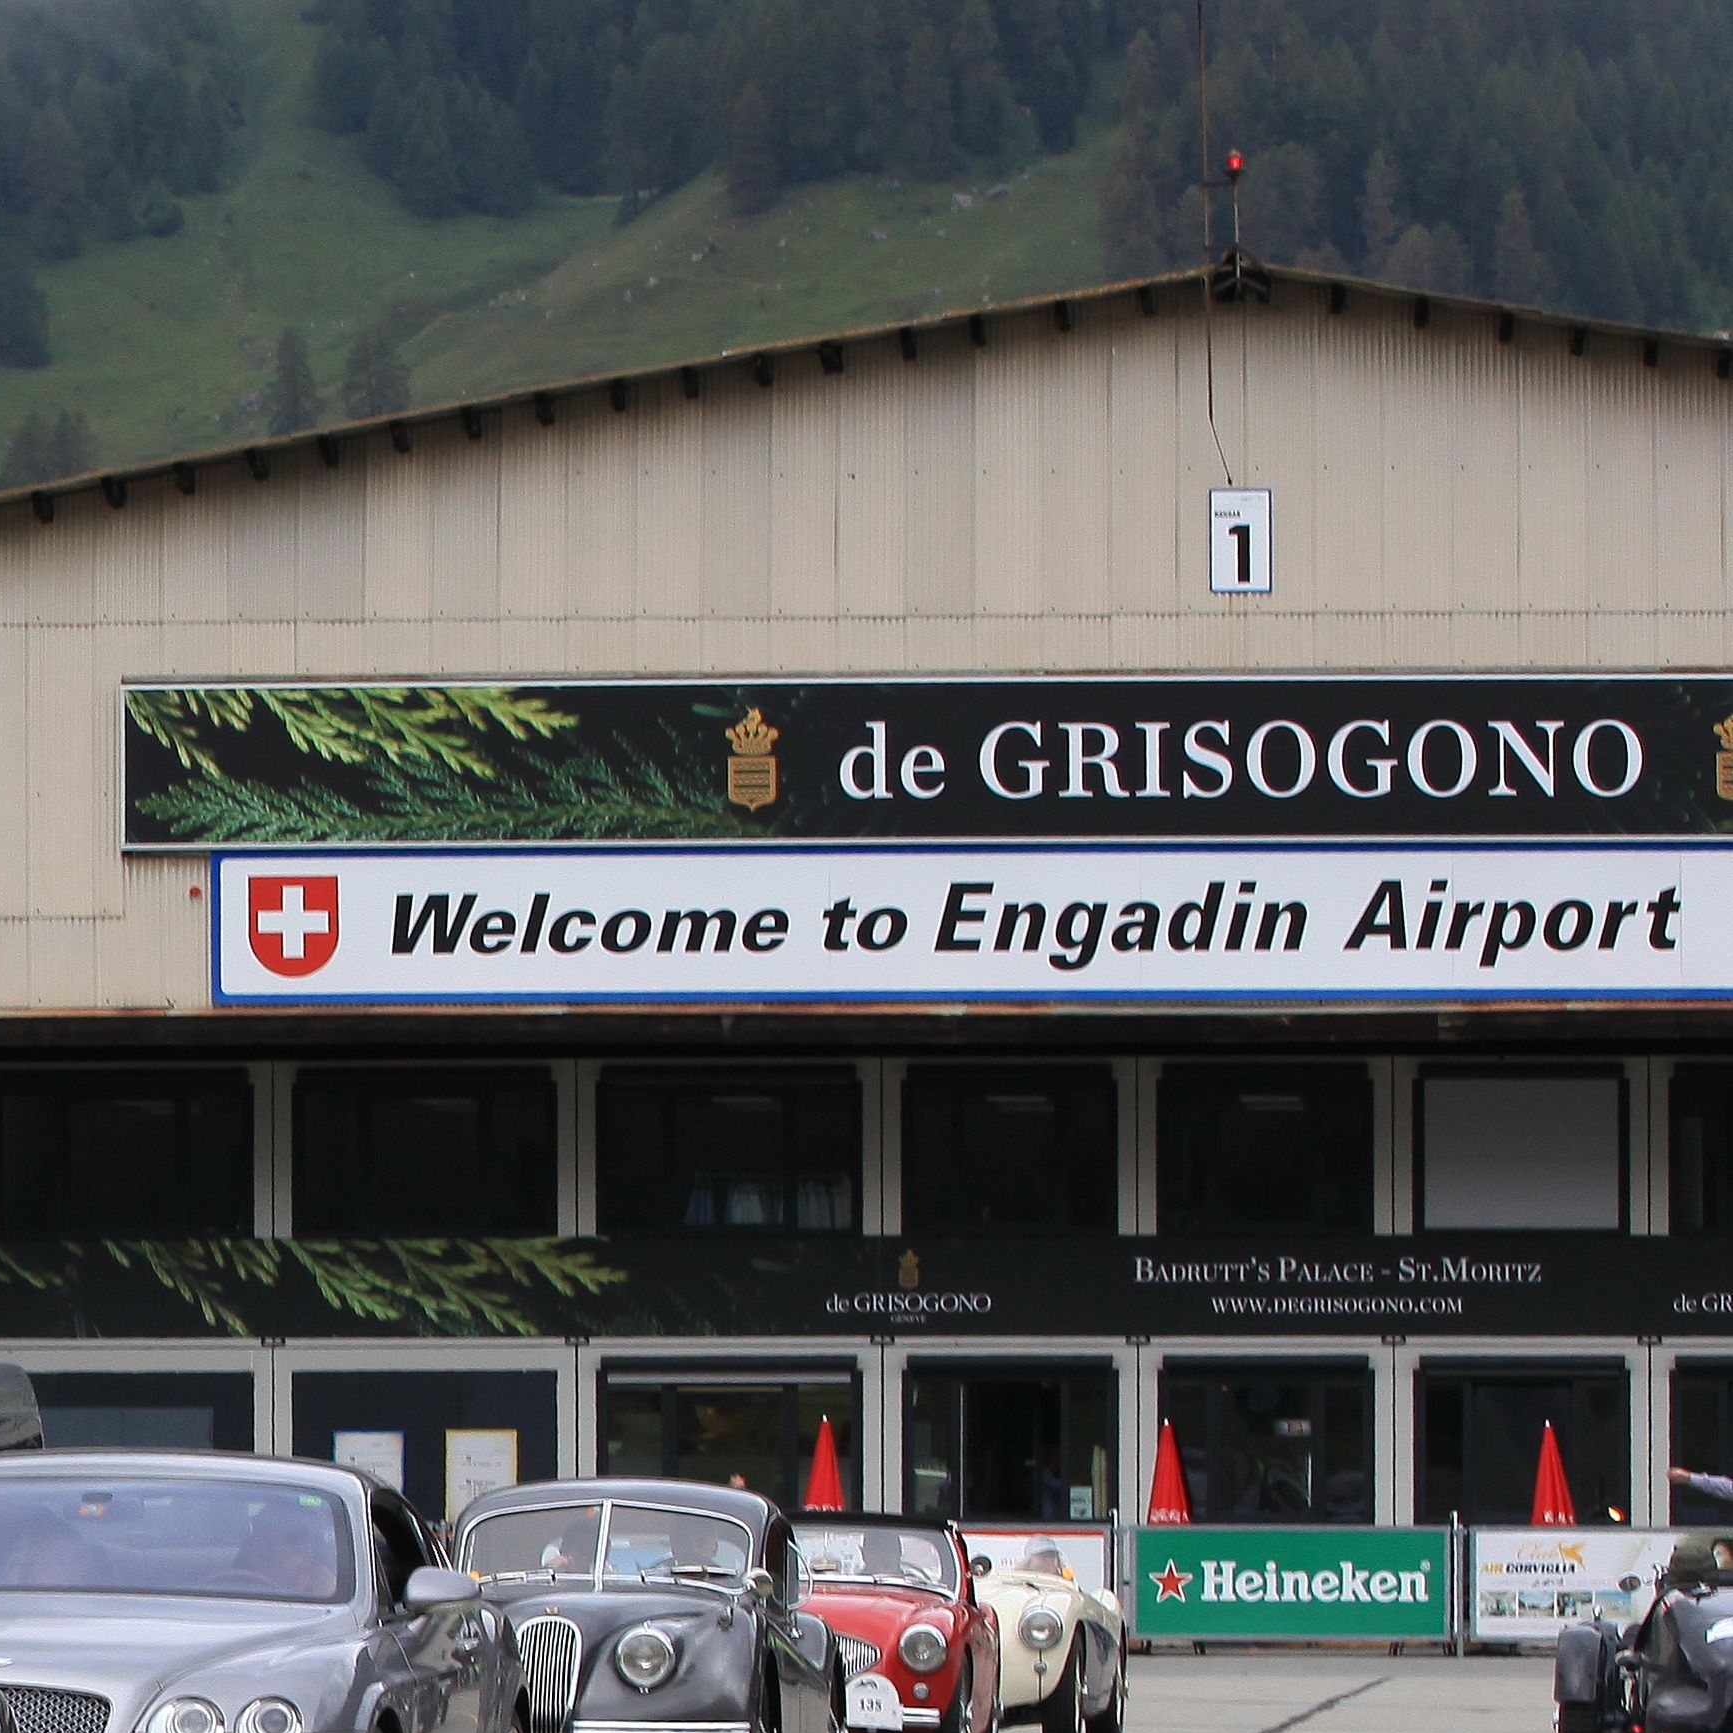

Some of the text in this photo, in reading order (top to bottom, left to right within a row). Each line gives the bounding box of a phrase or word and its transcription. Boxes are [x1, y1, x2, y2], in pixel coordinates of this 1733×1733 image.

[1228, 523, 1251, 583] 1
[838, 719, 1644, 800] de GRISOGONO
[390, 877, 1682, 970] Welcome to Engadin Airport
[825, 1292, 992, 1313] de GRISOGONO
[1673, 1292, 1697, 1313] de
[1200, 1560, 1430, 1603] Heineken
